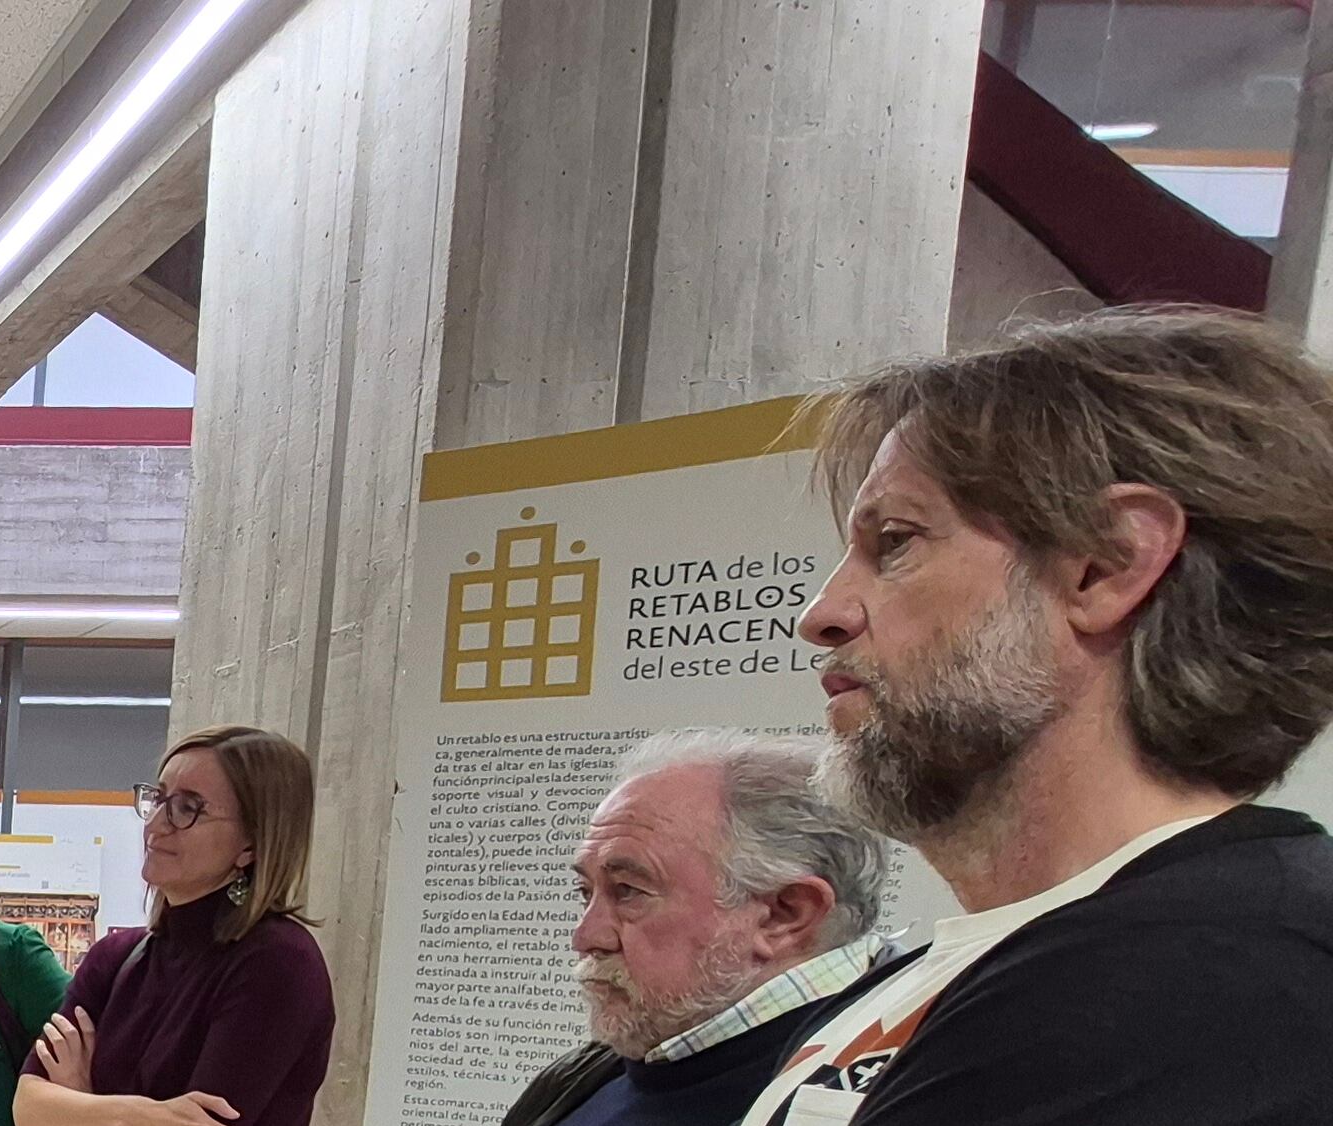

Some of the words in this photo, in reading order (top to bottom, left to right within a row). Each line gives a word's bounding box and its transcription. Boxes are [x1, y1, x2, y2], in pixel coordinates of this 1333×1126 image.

[631, 560, 717, 589] RUTA
[727, 555, 764, 580] de
[773, 552, 815, 576] los
[629, 583, 806, 619] RETABLOS
[626, 617, 796, 650] RENACEN
[623, 656, 662, 680] del
[670, 657, 731, 678] este
[740, 649, 779, 674] de
[791, 649, 823, 672] Le
[436, 734, 454, 746] Un
[455, 732, 501, 745] retablo
[502, 733, 517, 743] es
[519, 733, 543, 742] una
[544, 731, 611, 742] estructura
[612, 726, 655, 740] artísti-
[429, 803, 442, 815] el
[445, 802, 478, 815] culto
[481, 802, 541, 814] cristiano.
[422, 890, 482, 903] episodios
[484, 890, 501, 901] de
[503, 889, 514, 901] la
[516, 889, 560, 901] Pasión
[421, 908, 469, 923] Surgido
[470, 911, 487, 921] en
[488, 908, 499, 921] la
[501, 909, 534, 921] Edad
[535, 909, 578, 922] Media
[404, 1078, 446, 1090] región.
